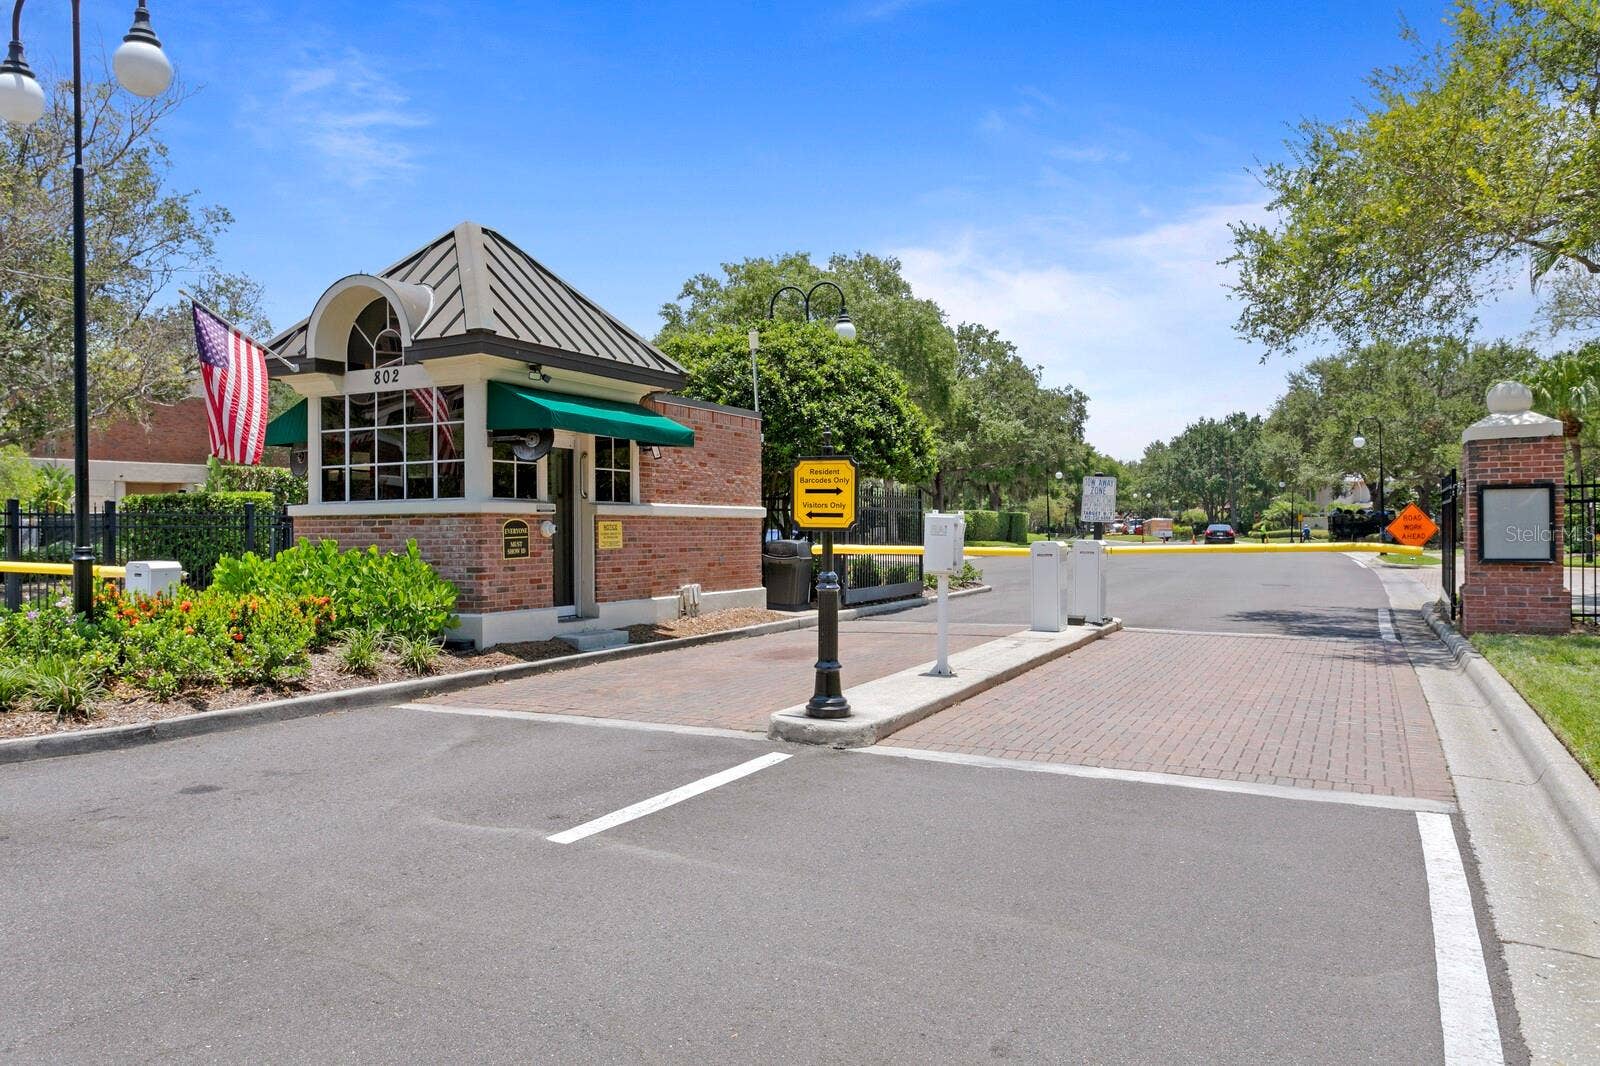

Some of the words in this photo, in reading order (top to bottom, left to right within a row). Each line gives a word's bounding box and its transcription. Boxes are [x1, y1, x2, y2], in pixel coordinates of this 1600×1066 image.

[374, 369, 399, 385] 802
[833, 477, 850, 486] Only
[1098, 479, 1114, 488] AWAY
[1090, 486, 1106, 495] ZONE
[802, 501, 829, 509] Visitors
[830, 501, 847, 510] Only
[504, 527, 529, 535] EVERYONE
